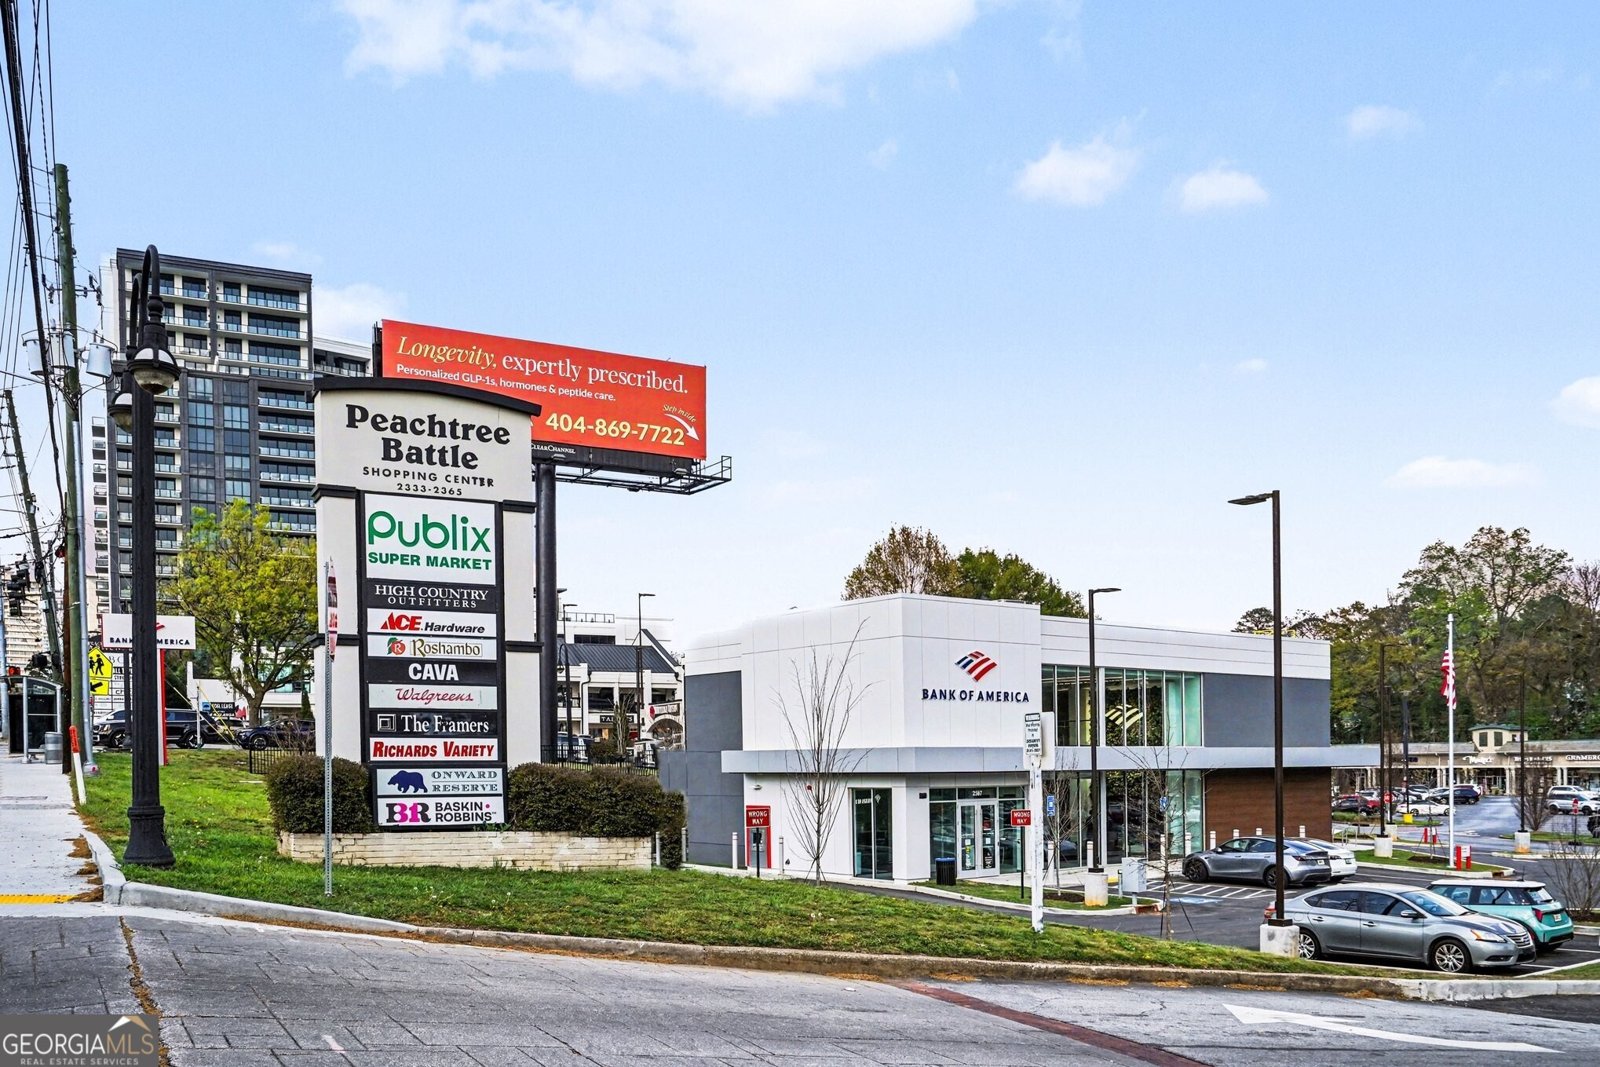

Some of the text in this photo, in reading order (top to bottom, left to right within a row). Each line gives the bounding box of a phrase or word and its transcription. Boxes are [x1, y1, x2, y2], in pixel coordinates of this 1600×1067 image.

[396, 335, 688, 394] Longevity, expertly prescribed.
[396, 364, 616, 401] Personalized GLP-1s, hormones & peptide care.
[345, 404, 510, 445] Peachtree
[545, 413, 685, 446] 404-869-7722
[381, 436, 478, 470] Battle
[363, 466, 494, 487] SHOPPING CENTER
[397, 482, 462, 496] 2333-2365
[368, 510, 491, 552] Publix
[368, 552, 492, 570] SUPER MARKET
[375, 584, 489, 600] HIGH COUNTRY
[387, 596, 477, 608] OUTFITTERS
[380, 612, 485, 634] ACE Hardware
[157, 638, 190, 646] MERICA
[412, 638, 481, 657] Roshambo
[408, 663, 459, 680] CAVA
[395, 688, 474, 705] Walgreens
[922, 689, 1030, 702] BANK OF AMERICA
[401, 714, 489, 733] The Framers
[372, 741, 495, 758] RICHARDS VARIETY
[431, 770, 498, 779] ONWARD
[432, 783, 498, 792] RESERVE
[435, 801, 483, 811] BASKIN
[748, 810, 768, 818] WRONG
[435, 812, 492, 822] ROBBINS
